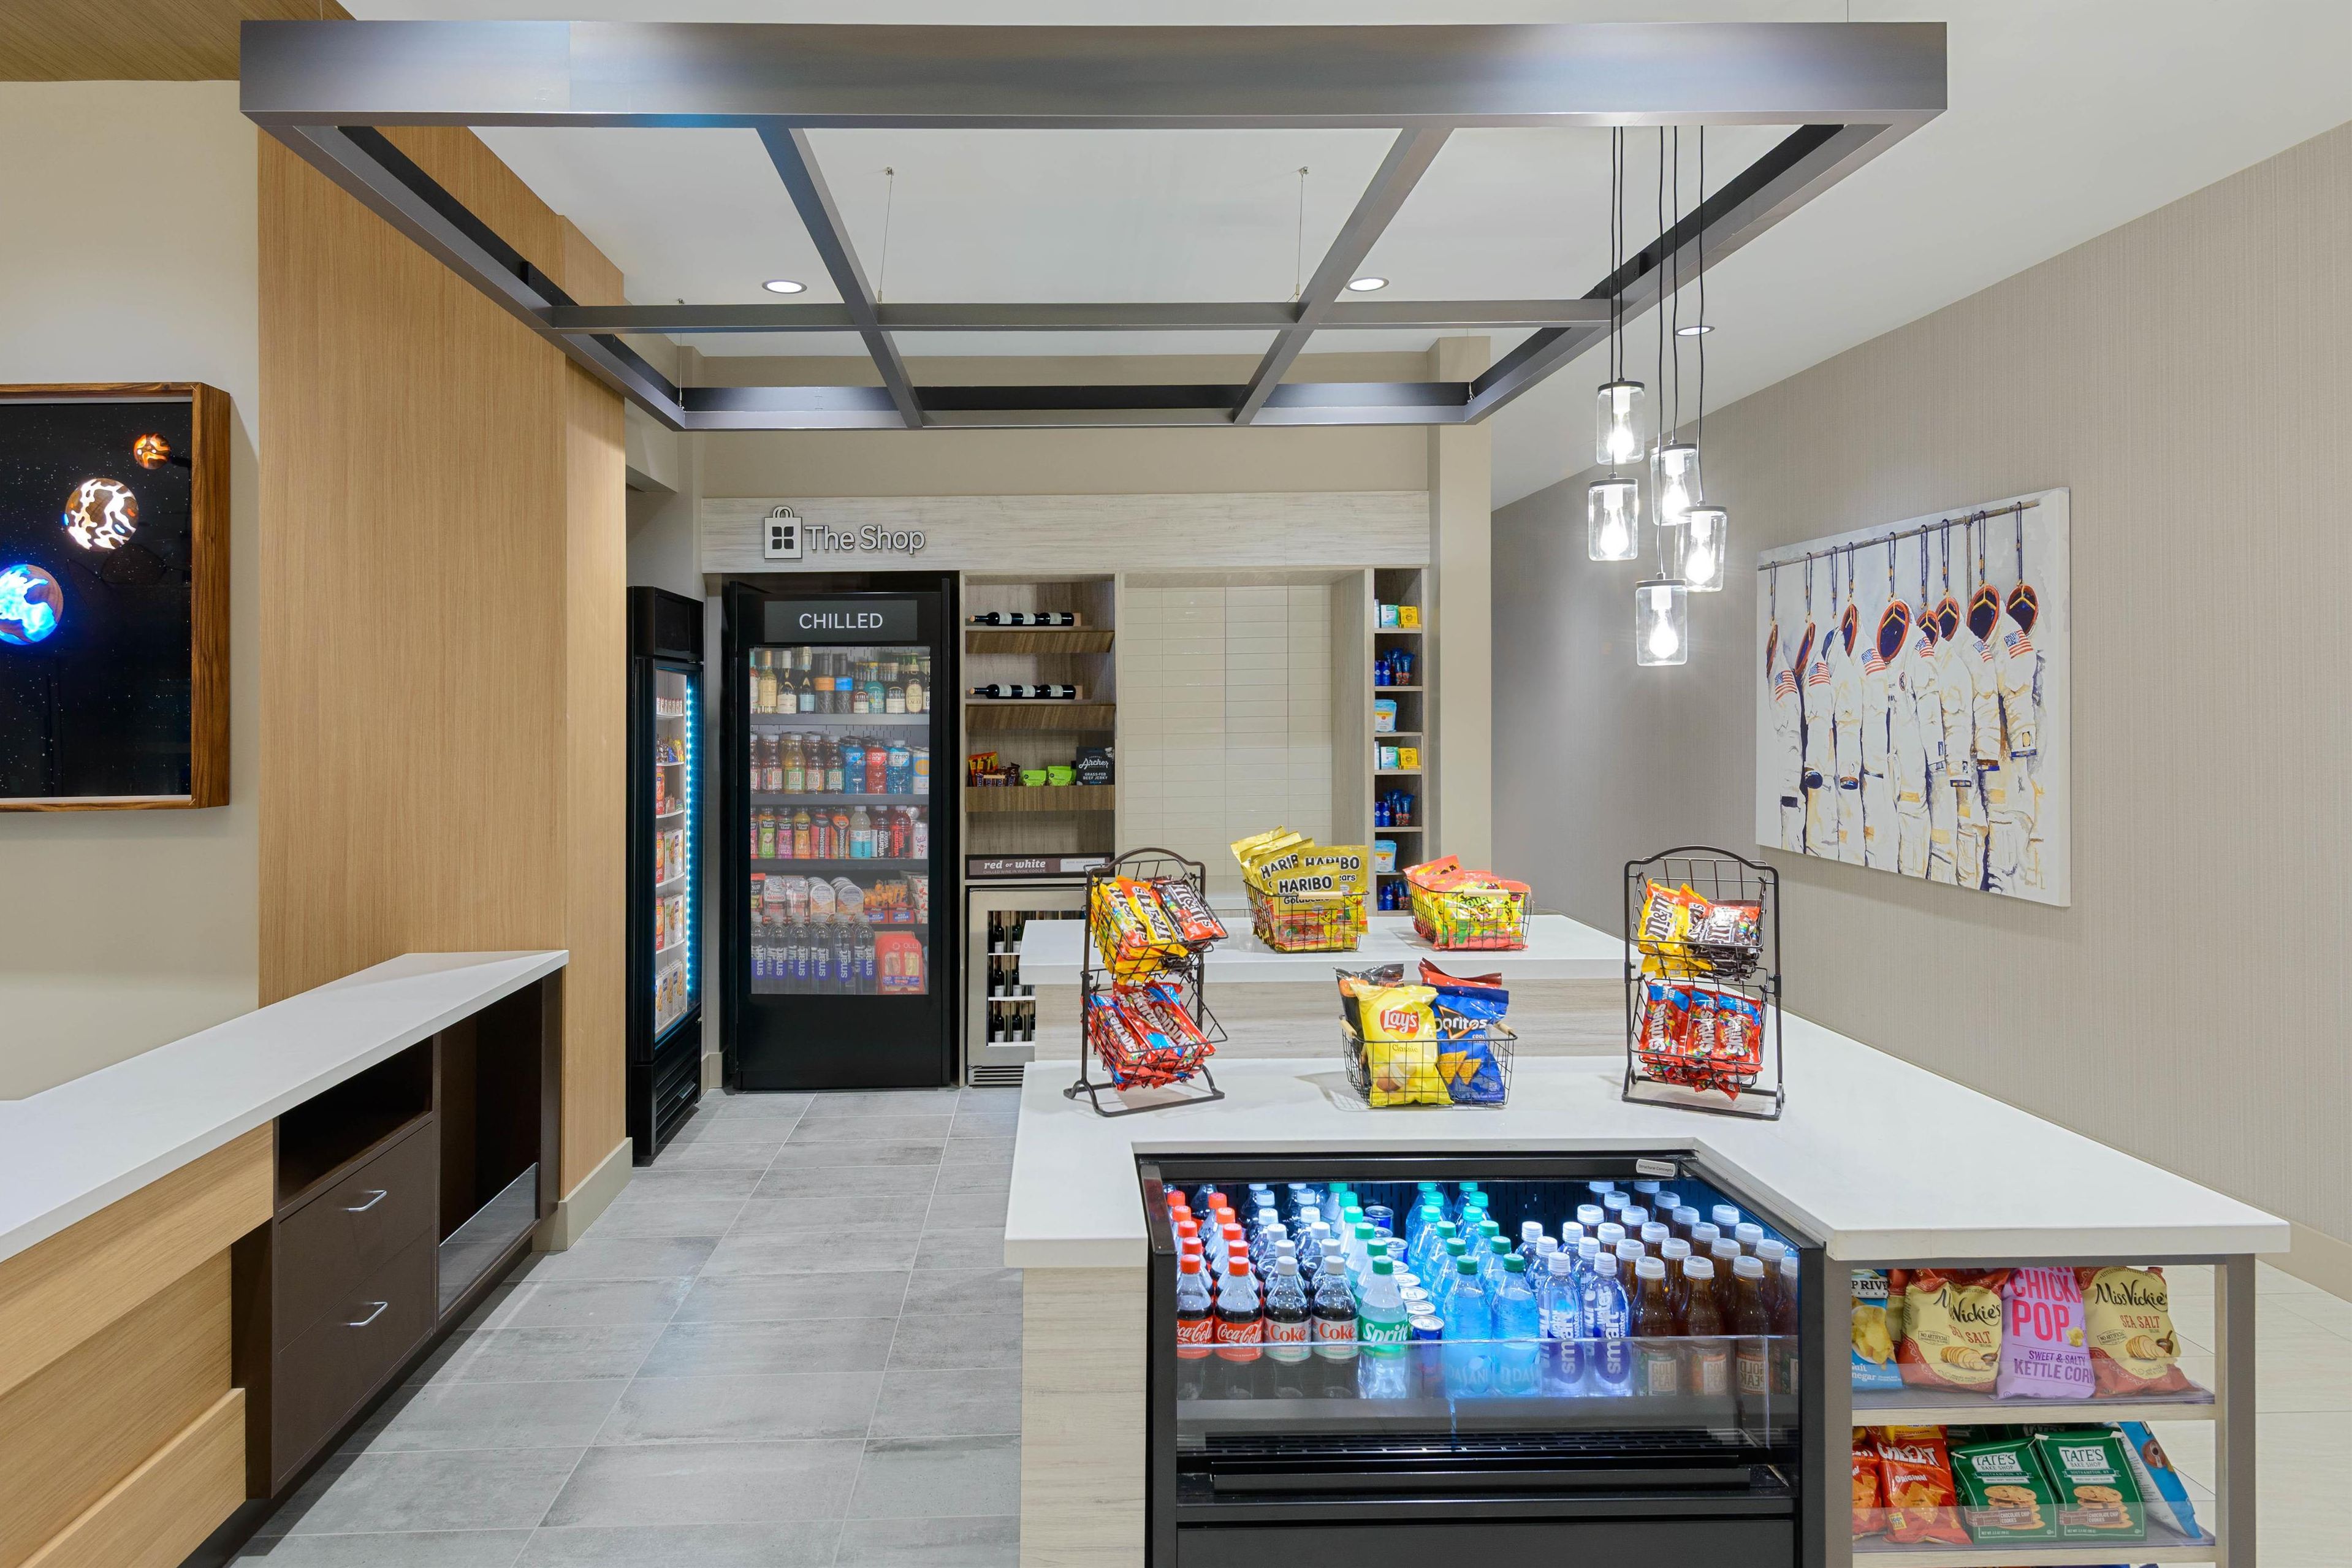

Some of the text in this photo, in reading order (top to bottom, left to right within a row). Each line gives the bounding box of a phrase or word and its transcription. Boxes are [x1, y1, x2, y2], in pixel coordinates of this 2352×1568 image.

[804, 525, 926, 555] The Shop
[799, 613, 883, 629] CHILLED
[1078, 758, 1109, 770] Archer
[984, 860, 1003, 869] red
[1015, 859, 1046, 869] white
[1279, 876, 1332, 893] HARIBO
[1383, 1010, 1418, 1033] Lay's
[2095, 1280, 2167, 1312] Miss Vickie'
[2012, 1300, 2070, 1342] POP
[2120, 1315, 2160, 1329] SEA SALT
[1177, 1320, 1213, 1342] oca-Cola
[1217, 1322, 1262, 1344] Coca-Cola
[1269, 1324, 1306, 1341] Coke
[1319, 1323, 1355, 1340] Coke
[1363, 1322, 1408, 1342] Sprite
[1965, 1331, 1992, 1344] SALT
[1605, 1312, 1621, 1374] smart
[2029, 1350, 2086, 1366] SWEET & SALTY
[1852, 1372, 1876, 1382] negar
[2014, 1358, 2094, 1384] KETTLE CORN
[1975, 1455, 2015, 1466] TATE'S
[2061, 1449, 2104, 1462] TATE'S
